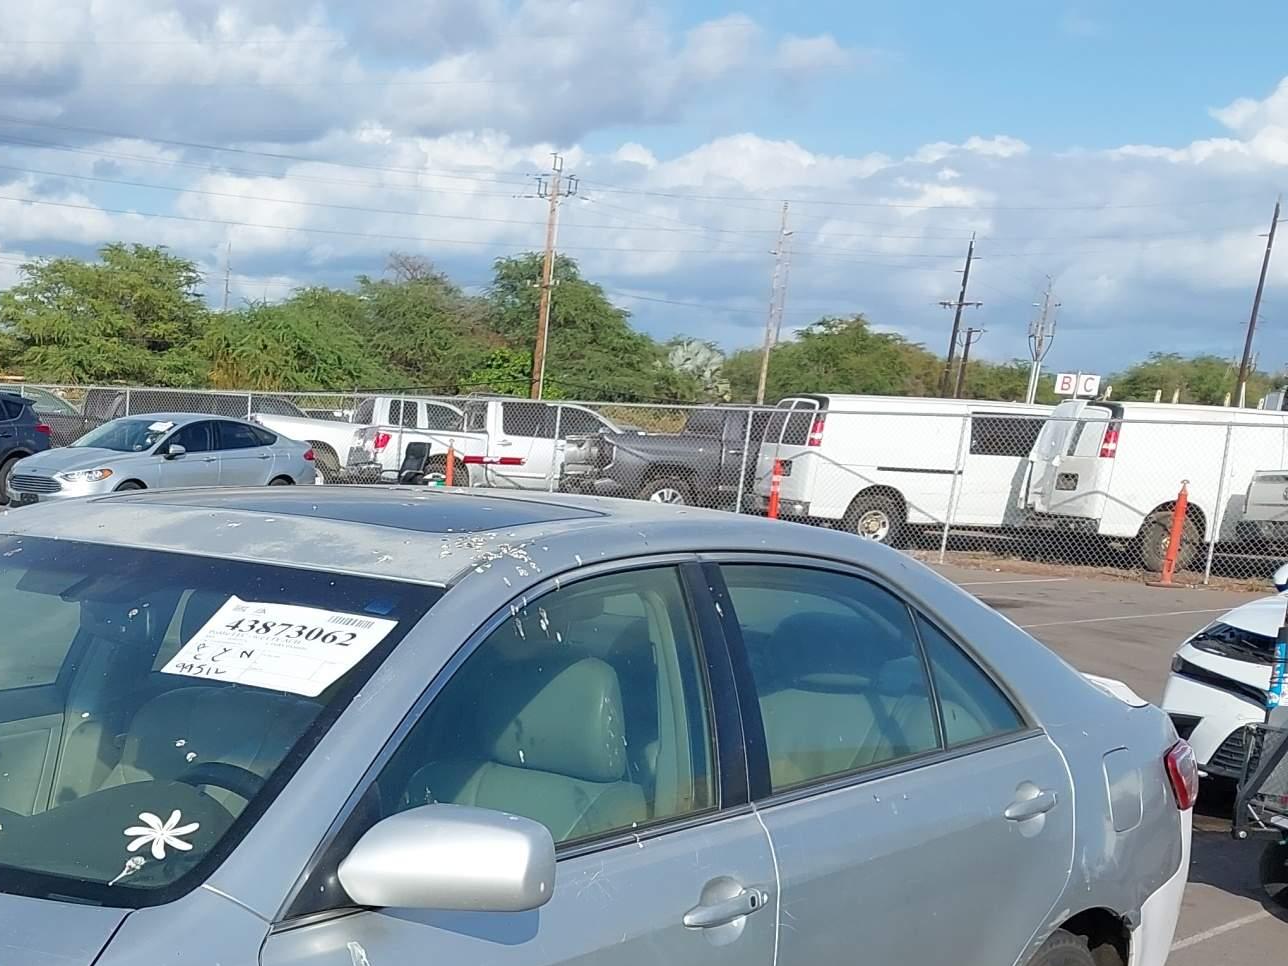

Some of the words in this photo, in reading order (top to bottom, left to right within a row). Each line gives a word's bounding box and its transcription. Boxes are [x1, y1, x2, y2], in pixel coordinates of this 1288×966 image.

[1061, 376, 1072, 391] B
[1083, 377, 1095, 393] C
[225, 618, 357, 647] 43873062
